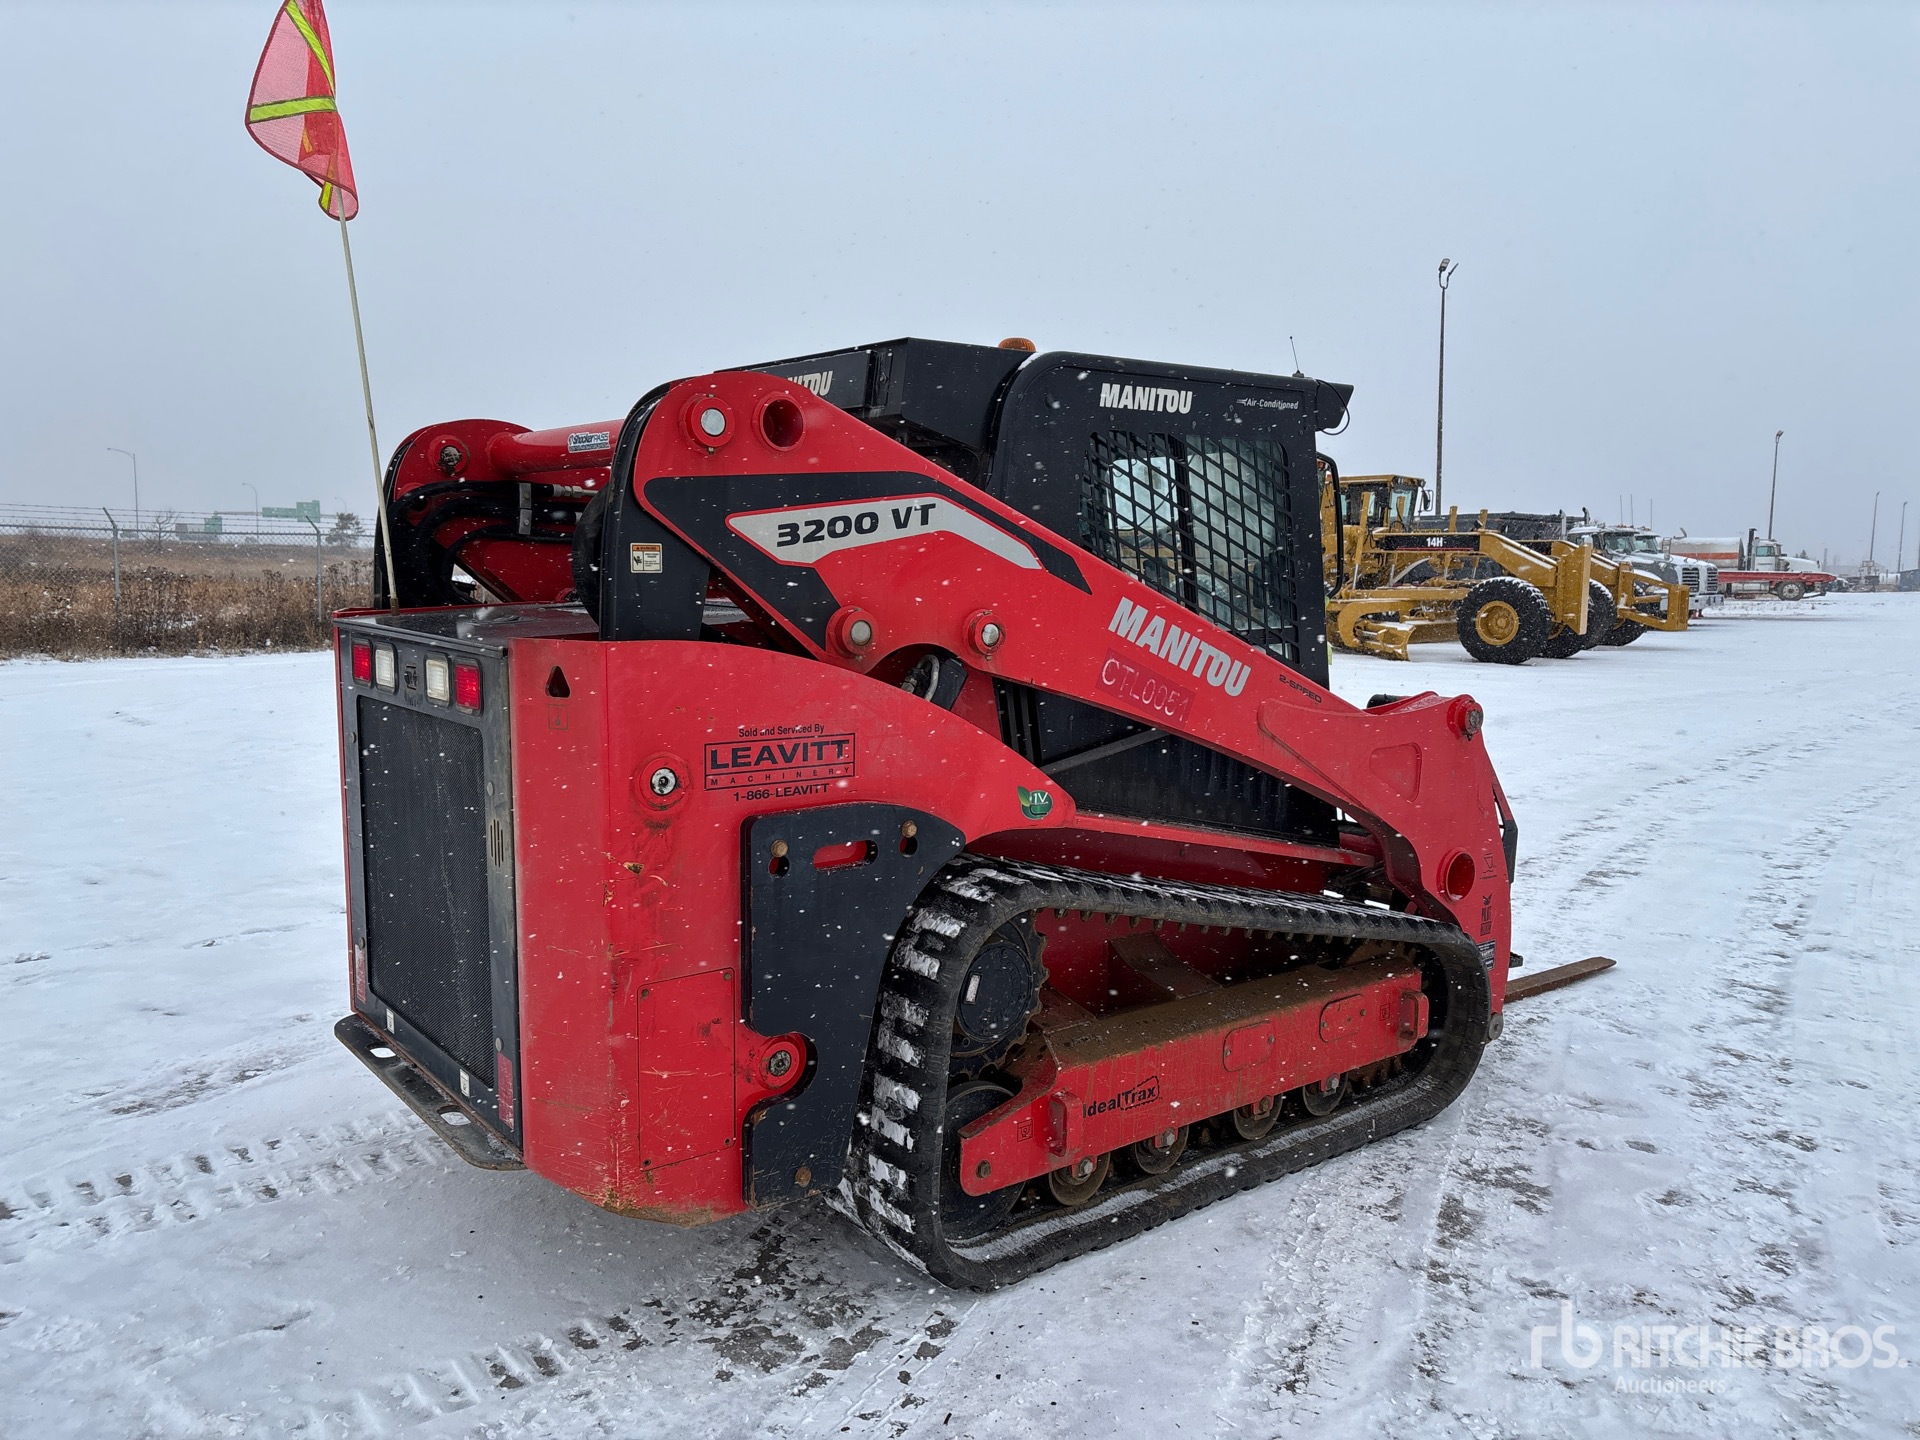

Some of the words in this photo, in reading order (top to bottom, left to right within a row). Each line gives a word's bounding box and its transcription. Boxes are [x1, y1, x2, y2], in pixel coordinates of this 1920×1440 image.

[1099, 382, 1193, 414] MANITOU
[1246, 398, 1299, 410] Air-Conditioned
[776, 511, 880, 548] 3200
[891, 503, 937, 530] VT
[1426, 536, 1444, 548] 14H
[1108, 596, 1251, 697] MANITOU
[1278, 674, 1323, 704] 2-SPEED
[738, 727, 758, 738] Sold
[760, 725, 775, 736] and
[777, 724, 812, 735] Serviced
[814, 723, 825, 734] By
[710, 739, 850, 770] LEAVITT
[710, 766, 850, 786] MACHINERY
[733, 783, 830, 802] 1-866-LEAVITT
[1082, 1086, 1157, 1119] IdealTrax
